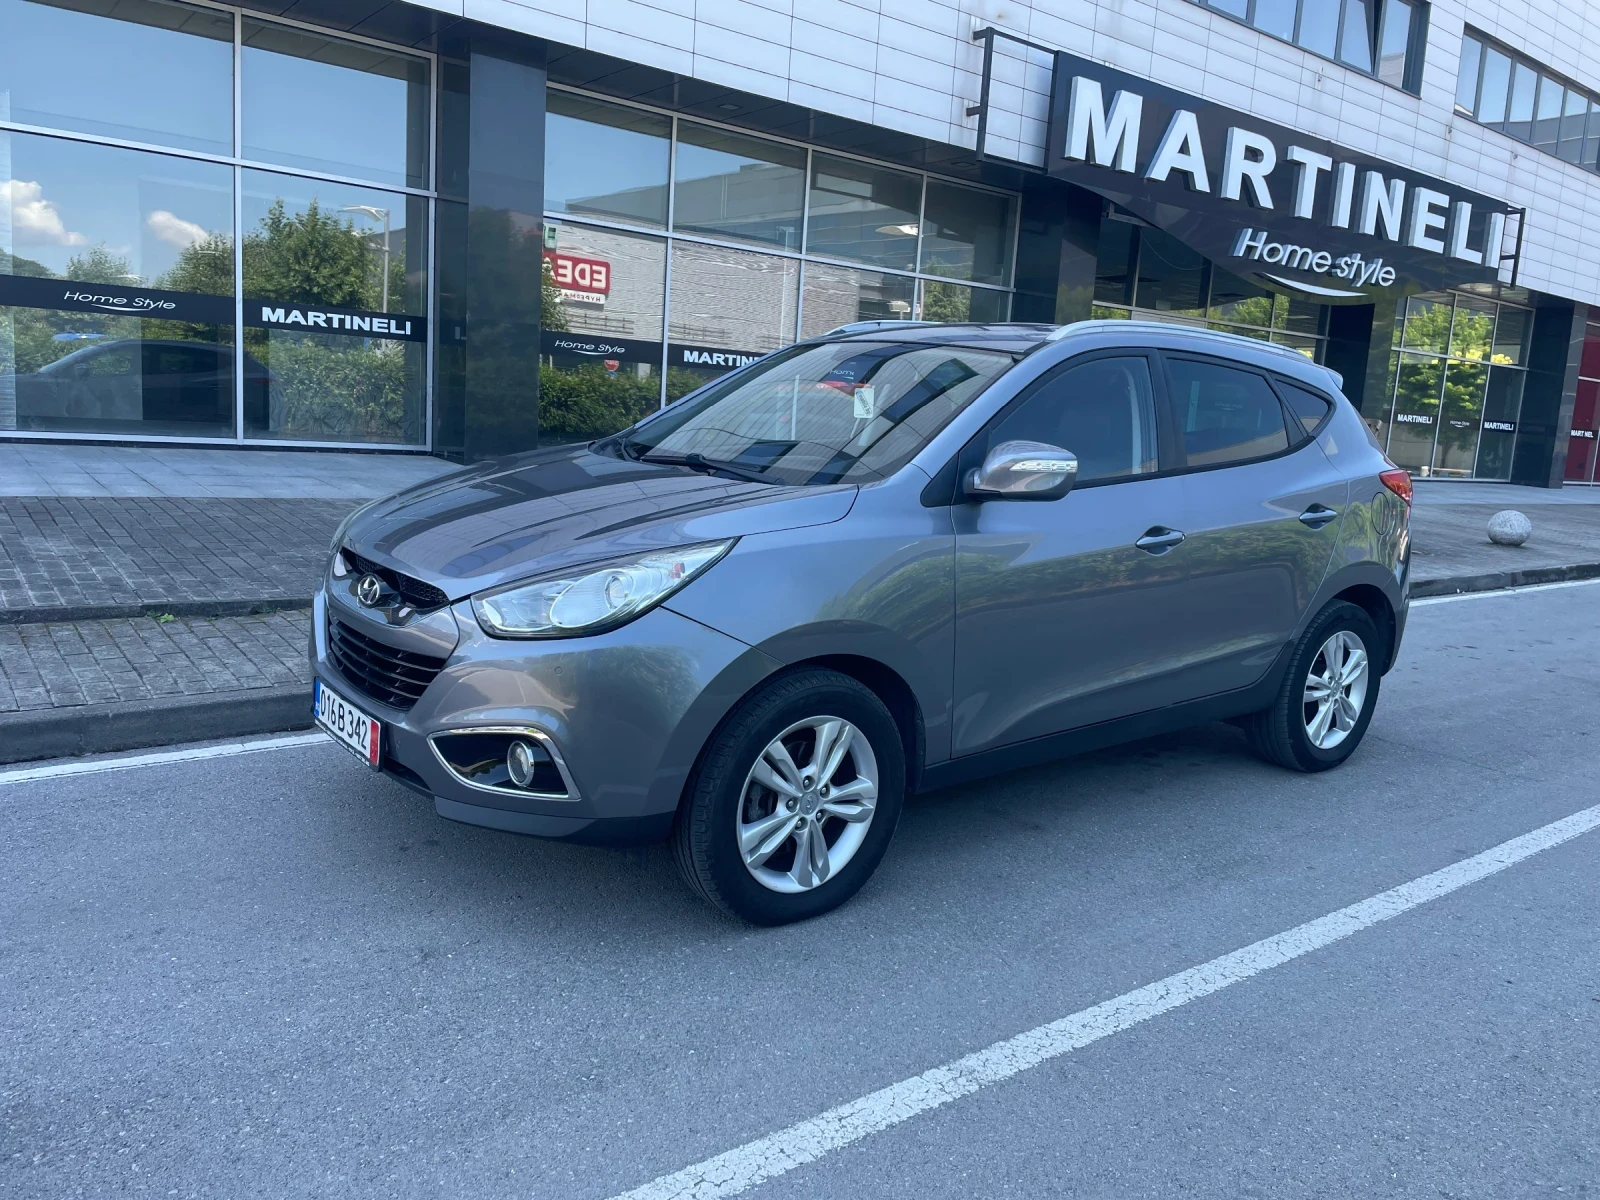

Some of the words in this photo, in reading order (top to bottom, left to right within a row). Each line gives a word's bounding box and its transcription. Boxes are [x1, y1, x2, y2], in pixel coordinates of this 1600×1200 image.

[1065, 75, 1505, 269] MARTINELI
[1233, 228, 1332, 273] Home
[1335, 252, 1396, 288] style
[63, 290, 128, 305] Home
[132, 297, 176, 310] Style
[261, 306, 412, 336] MARTINELI
[554, 339, 595, 350] Home
[597, 343, 626, 354] Style
[1397, 413, 1433, 425] MARTINELI
[1483, 421, 1514, 431] MARTINELI
